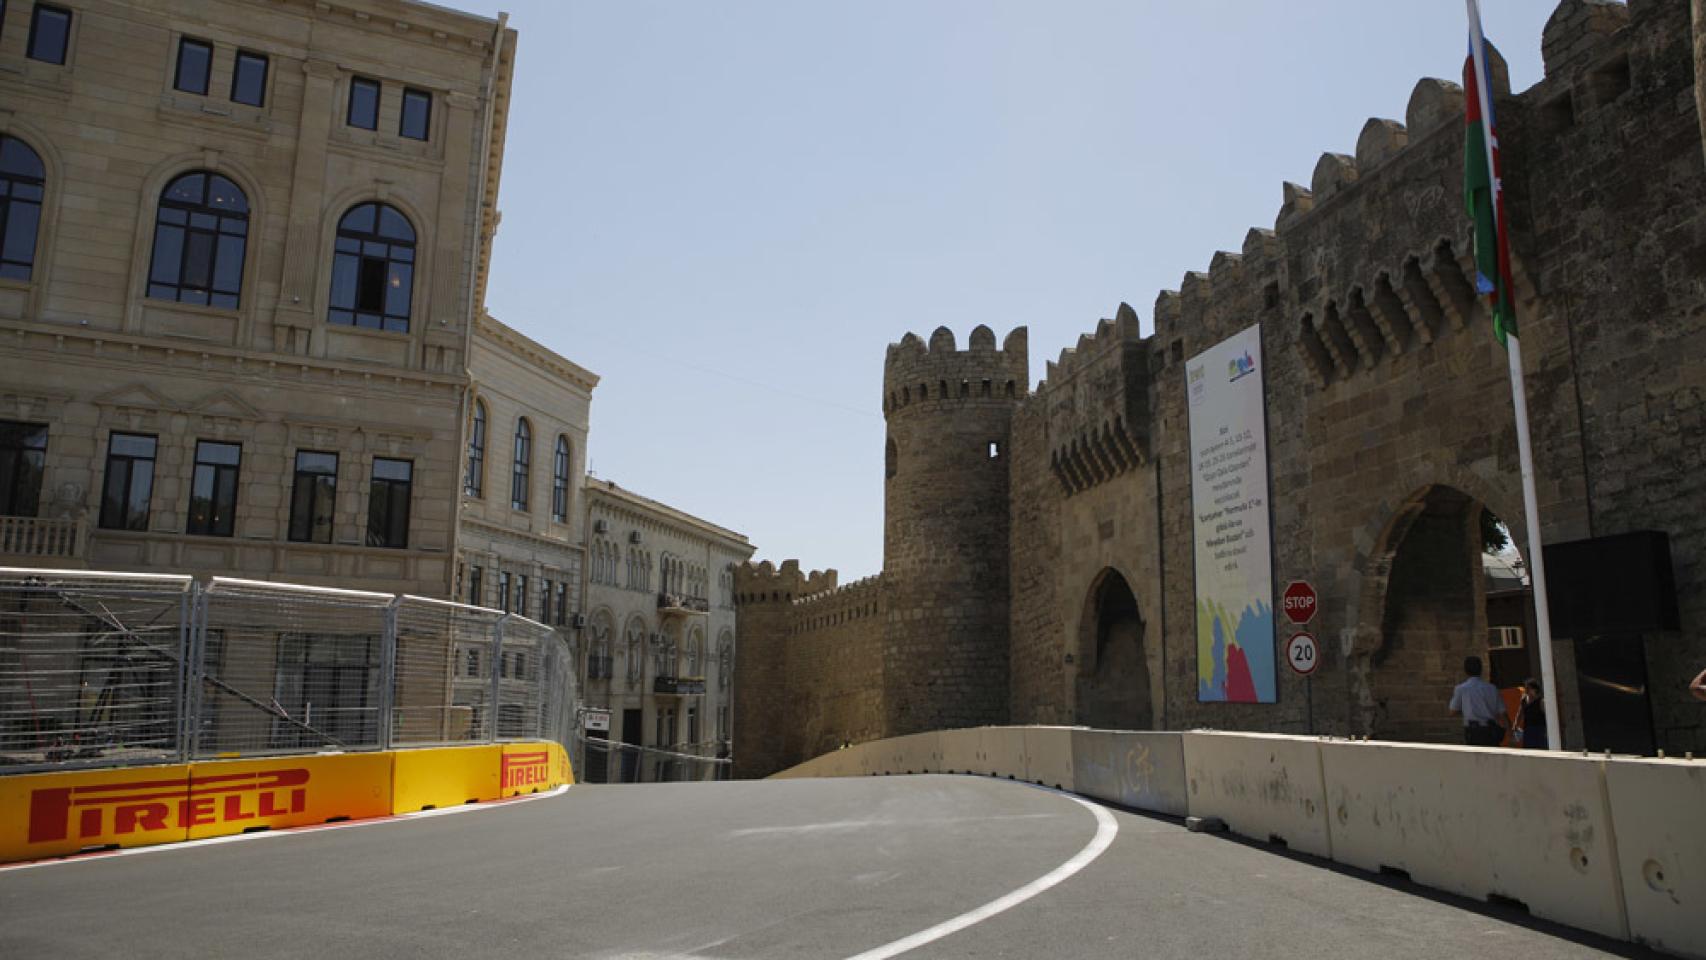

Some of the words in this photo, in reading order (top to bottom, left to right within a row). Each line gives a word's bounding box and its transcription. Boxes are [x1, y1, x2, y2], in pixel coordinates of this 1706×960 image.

[1286, 596, 1314, 609] STOP
[1295, 644, 1313, 661] 20
[28, 768, 310, 843] PIRELLI
